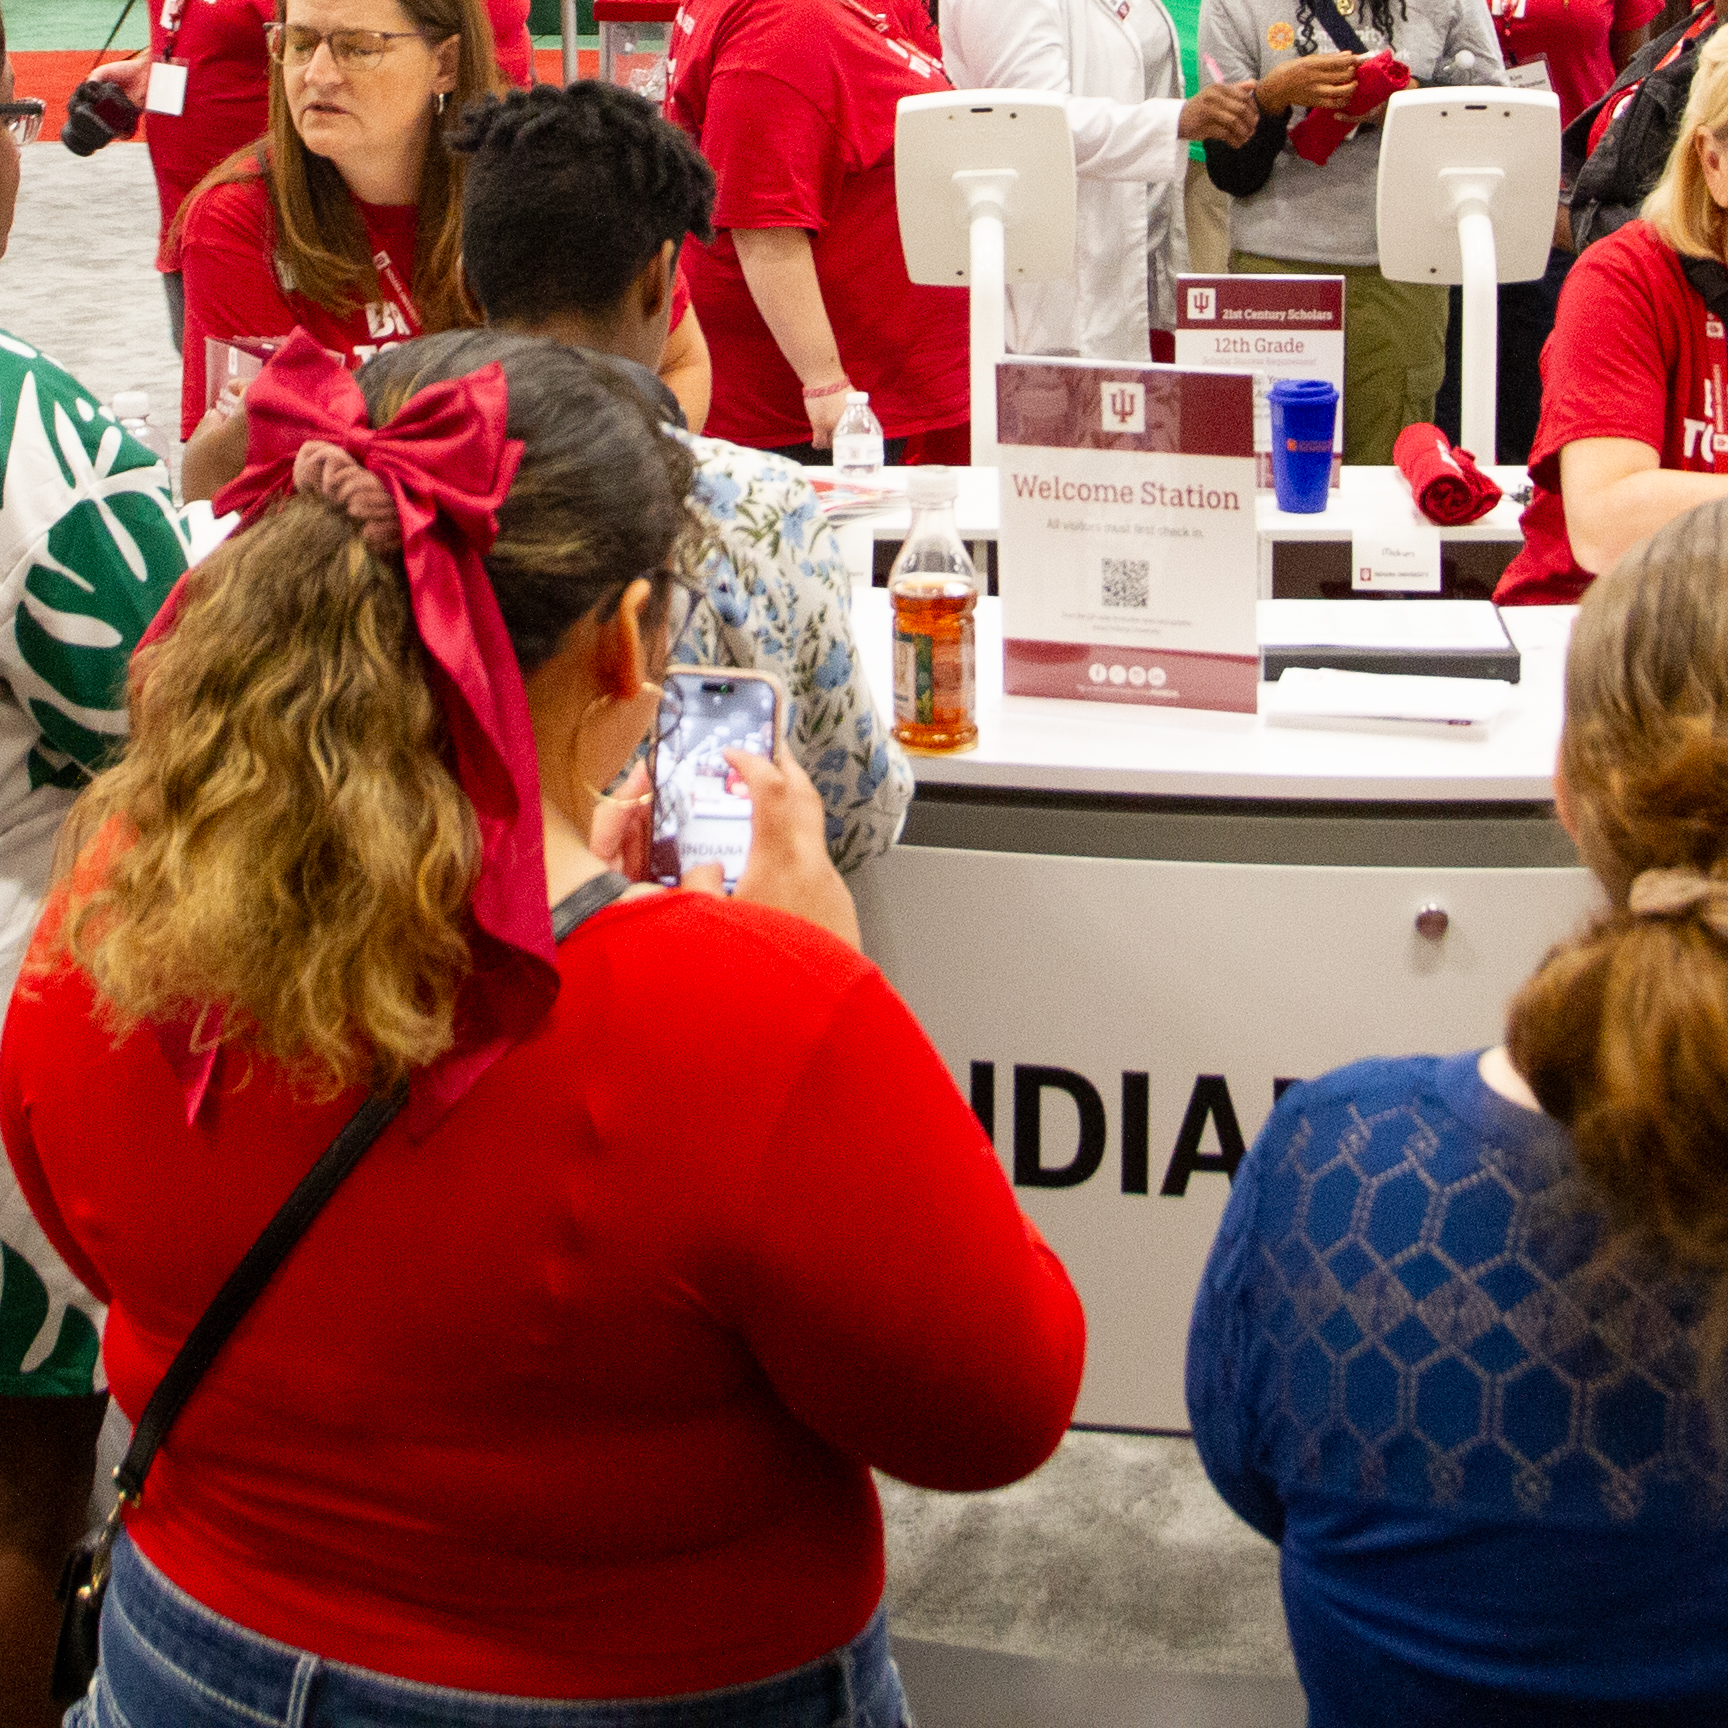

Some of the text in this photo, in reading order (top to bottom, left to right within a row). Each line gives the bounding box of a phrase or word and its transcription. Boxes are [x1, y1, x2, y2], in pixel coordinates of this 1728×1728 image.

[1243, 308, 1287, 322] Century
[1287, 307, 1334, 320] Scholars
[1214, 336, 1306, 353] 12th Grade
[1012, 473, 1241, 511] Welcome Station
[970, 1059, 1248, 1197] DIA
